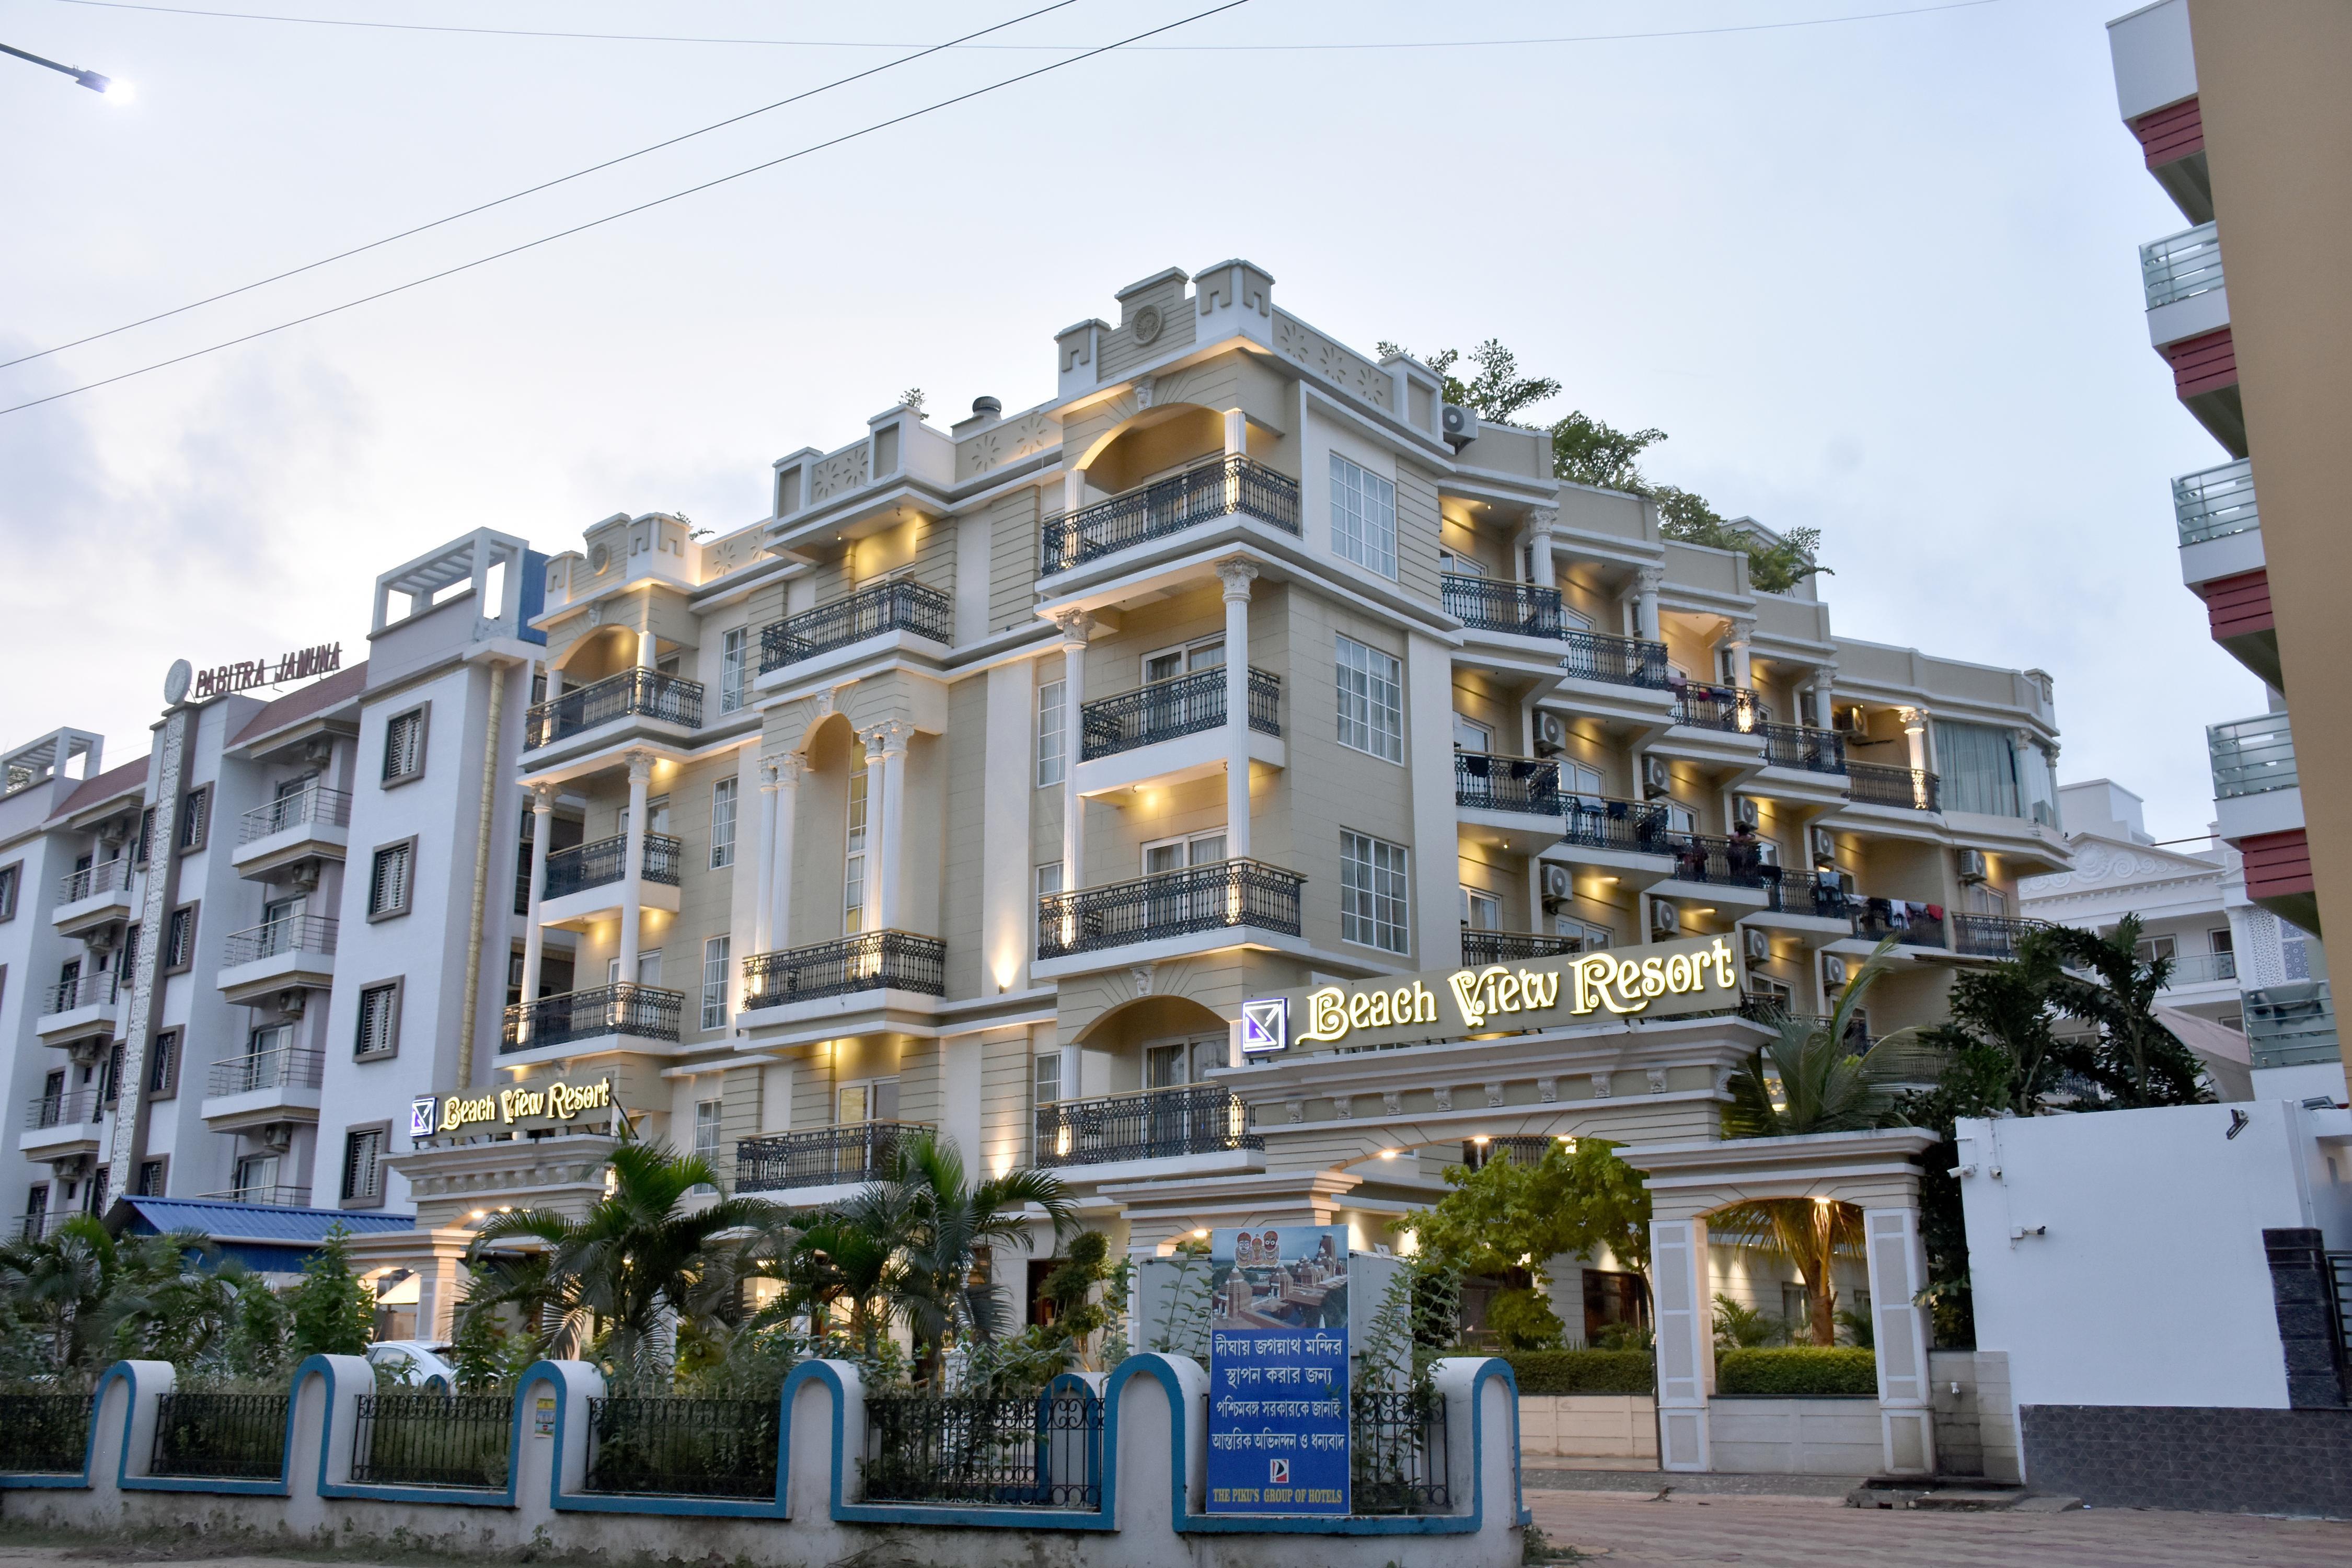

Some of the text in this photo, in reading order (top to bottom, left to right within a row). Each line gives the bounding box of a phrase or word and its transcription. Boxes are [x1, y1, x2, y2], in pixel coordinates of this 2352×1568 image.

[195, 641, 341, 698] PABITRA JAMUNA
[1295, 938, 1737, 1046] Beach View Resort
[437, 1077, 609, 1132] Beach View Resort
[1215, 1332, 1343, 1356] দীঘায় জগন্নাথ মন্দির
[1225, 1366, 1333, 1389] স্থাপন করার জন্য
[1217, 1395, 1341, 1419] পশ্চিমবঙ্গ সরকারকে জানাই
[1212, 1427, 1345, 1451] আন্তরিক অভিনন্দন ও ধন্যবাদ
[1213, 1489, 1342, 1504] THE PIKU'S GROUP OF HOTELS
